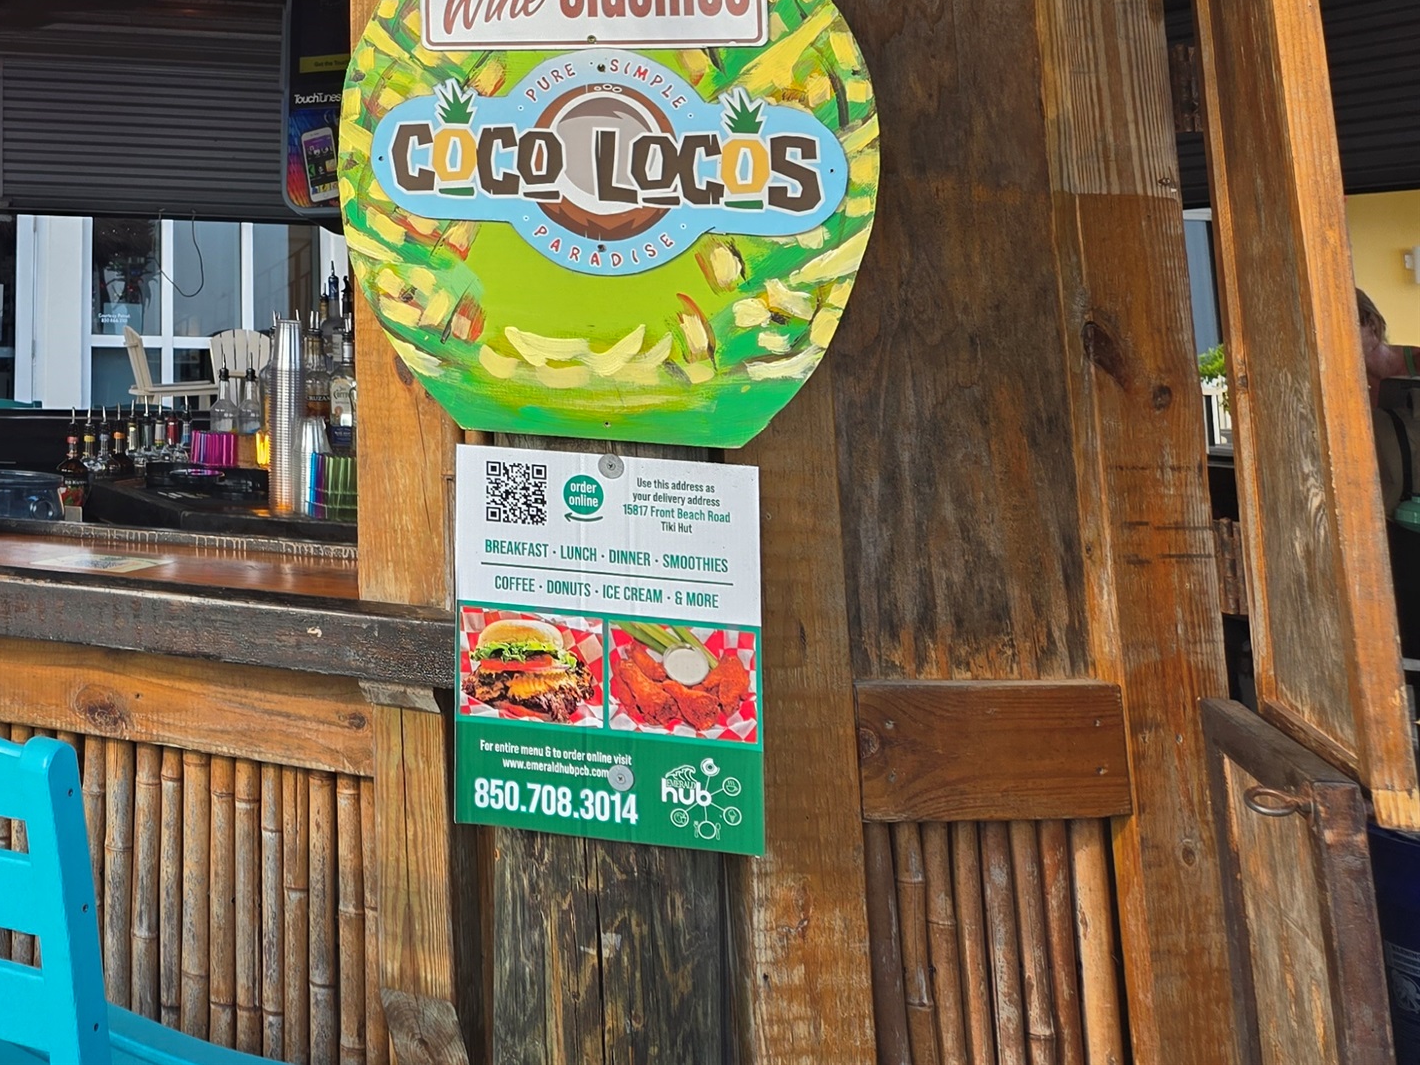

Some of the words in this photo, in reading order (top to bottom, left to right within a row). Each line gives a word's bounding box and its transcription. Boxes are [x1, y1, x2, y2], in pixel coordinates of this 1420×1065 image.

[525, 63, 576, 102] PURE
[609, 58, 687, 109] SIMPLE
[294, 93, 342, 104] TouchTunes
[391, 122, 566, 202] COCO
[594, 127, 824, 213] LOCOS
[533, 225, 675, 268] PARADISE
[570, 480, 597, 494] order
[636, 477, 652, 488] Use
[653, 479, 669, 490] this
[671, 481, 704, 492] address
[705, 484, 715, 493] as
[568, 494, 599, 508] online
[632, 492, 651, 502] your
[652, 493, 686, 506] delivery
[687, 496, 721, 507] address
[622, 504, 648, 516] 15817
[650, 506, 675, 519] Front
[677, 508, 706, 521] Beach
[707, 510, 731, 523] Road
[661, 521, 676, 532] Tiki
[677, 523, 693, 534] Hut
[484, 539, 549, 558] BREAKFAST
[560, 545, 597, 562] LUNCH
[608, 548, 651, 567] DINNER
[662, 554, 729, 573] SMOOTHIES
[494, 575, 536, 593] COFFEE
[546, 579, 591, 597] DONUTS
[602, 584, 622, 600] ICE
[623, 586, 663, 604] CREAM
[674, 591, 683, 606] &
[686, 591, 719, 609] MORE
[480, 739, 494, 752] For
[495, 742, 519, 754] entire
[520, 746, 544, 758] menu
[545, 746, 552, 758] &
[552, 748, 562, 759] to
[563, 748, 586, 761] order
[586, 751, 612, 764] online
[613, 753, 632, 766] visit
[502, 758, 610, 778] www.emeraldhubpcb.com
[661, 777, 712, 807] hub
[666, 779, 698, 790] EMERALD
[474, 777, 639, 825] 850.708.3014
